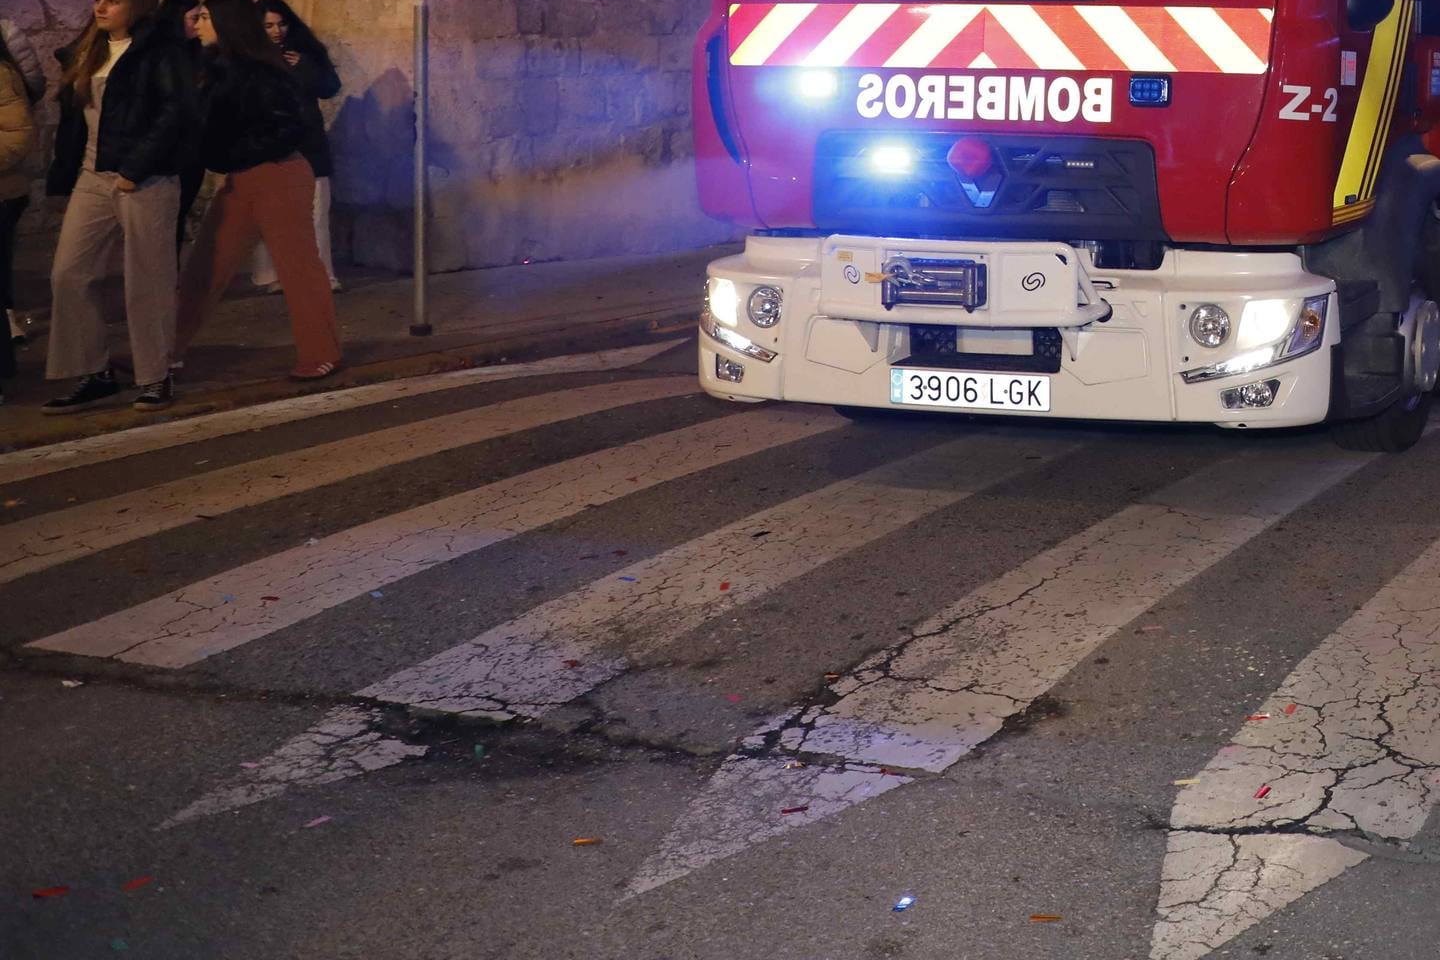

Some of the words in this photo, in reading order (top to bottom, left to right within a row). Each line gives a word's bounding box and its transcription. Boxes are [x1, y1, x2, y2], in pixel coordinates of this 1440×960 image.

[1279, 84, 1338, 122] Z-2
[910, 375, 978, 403] 3906
[990, 378, 1042, 406] LGK
